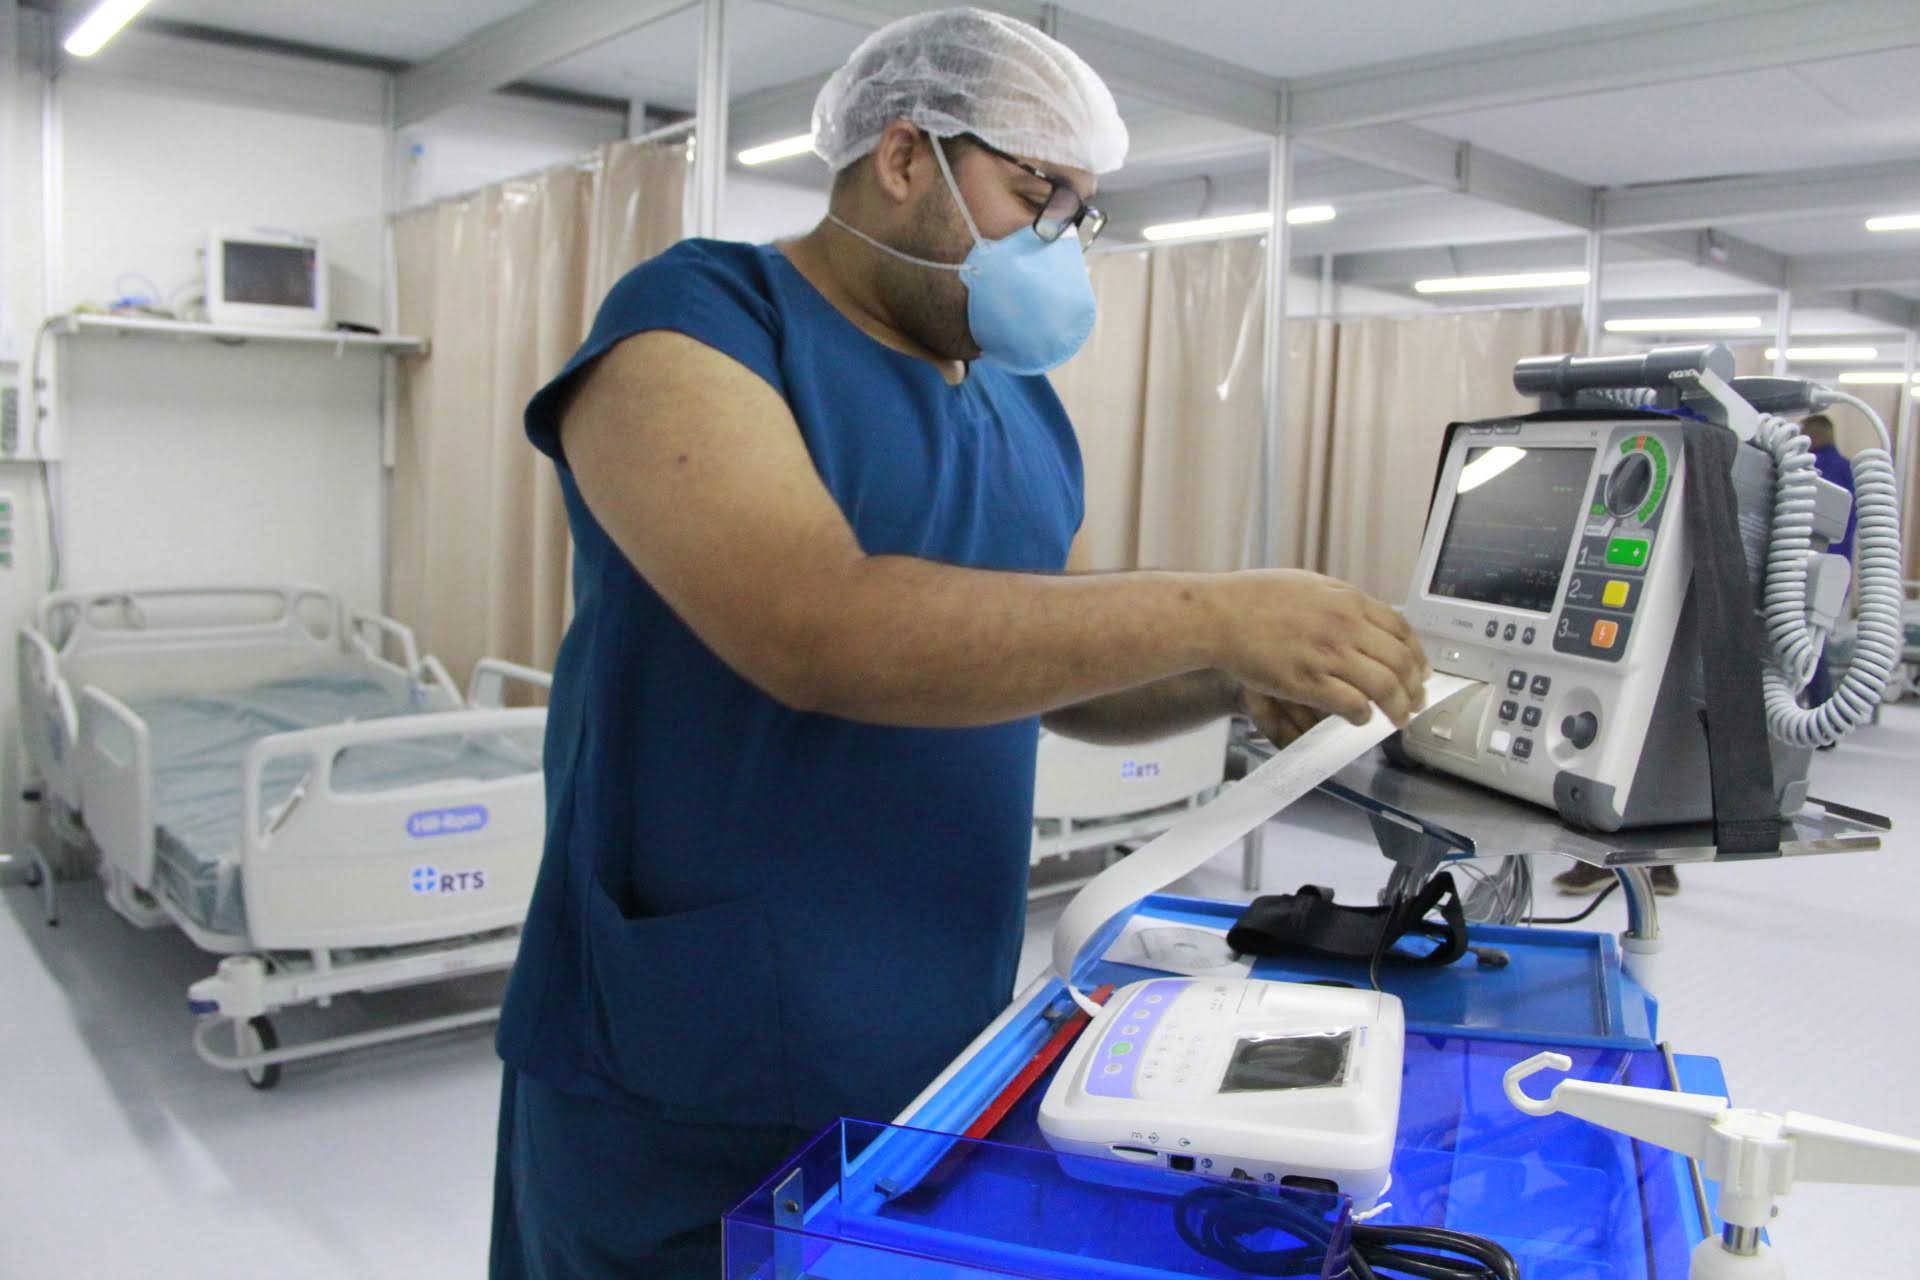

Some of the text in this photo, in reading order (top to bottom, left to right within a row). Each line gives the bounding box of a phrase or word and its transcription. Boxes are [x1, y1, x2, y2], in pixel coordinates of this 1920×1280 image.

[1578, 545, 1588, 565] 1
[1568, 578, 1582, 598] 2
[1558, 618, 1569, 637] 3
[440, 871, 485, 893] RTS
